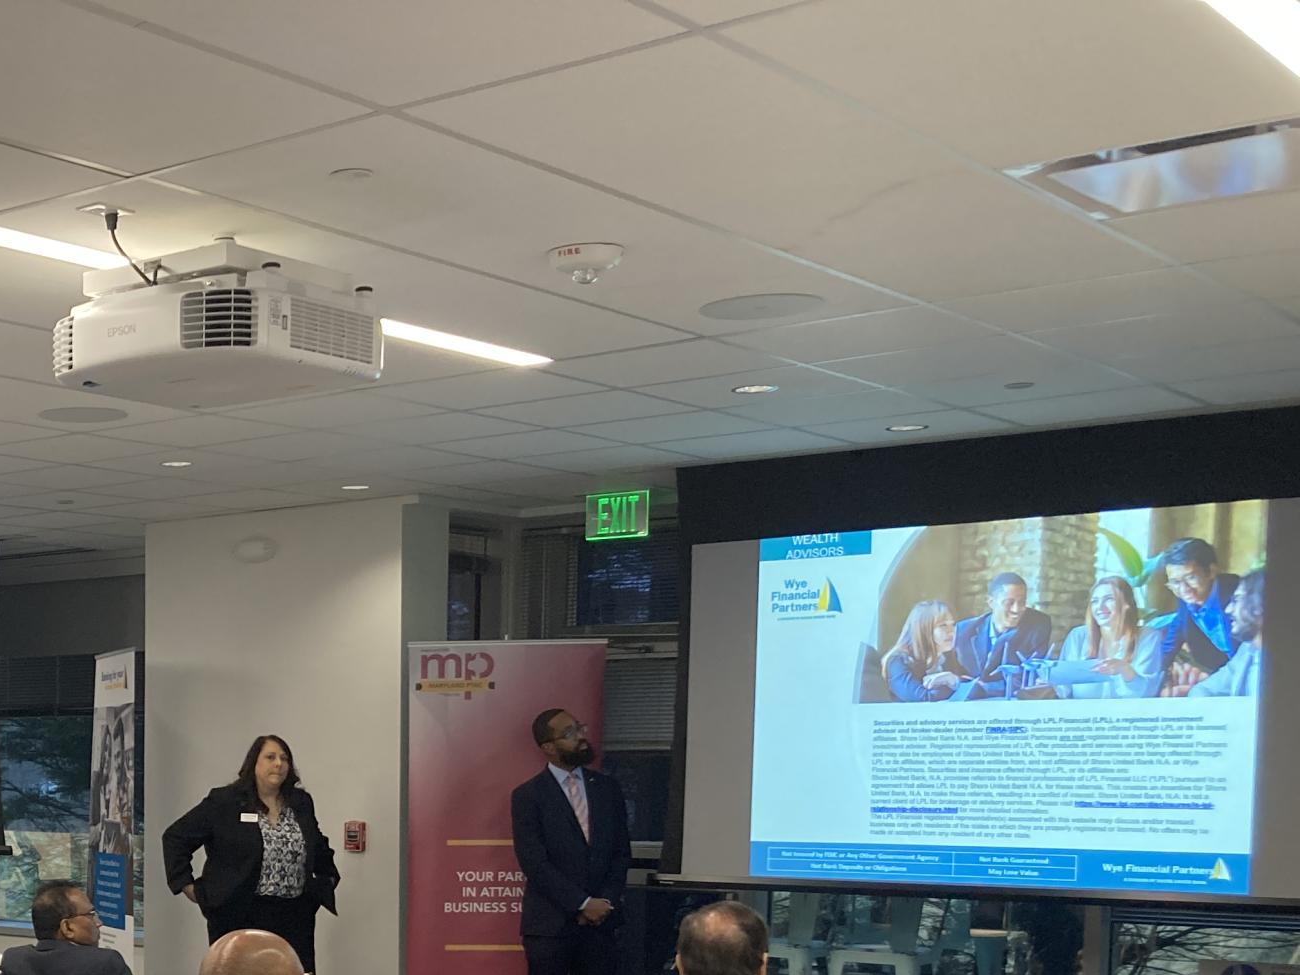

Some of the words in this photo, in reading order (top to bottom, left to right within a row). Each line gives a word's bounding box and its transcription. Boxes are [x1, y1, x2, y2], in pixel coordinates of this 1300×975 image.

[558, 248, 580, 256] FIRE
[108, 324, 136, 338] EPSON
[597, 496, 640, 534] EXIT
[791, 533, 838, 546] WEALTH
[786, 546, 844, 560] ADVISORS
[784, 580, 808, 590] Wye
[771, 589, 820, 601] Financial
[772, 602, 818, 612] Partners
[420, 652, 494, 700] mp
[1102, 863, 1122, 873] Wye
[1125, 864, 1170, 873] Financial
[1172, 865, 1213, 874] Partners
[456, 872, 494, 882] YOUR
[498, 872, 527, 882] PAR
[462, 887, 476, 897] IN
[444, 902, 506, 912] BUSINESS
